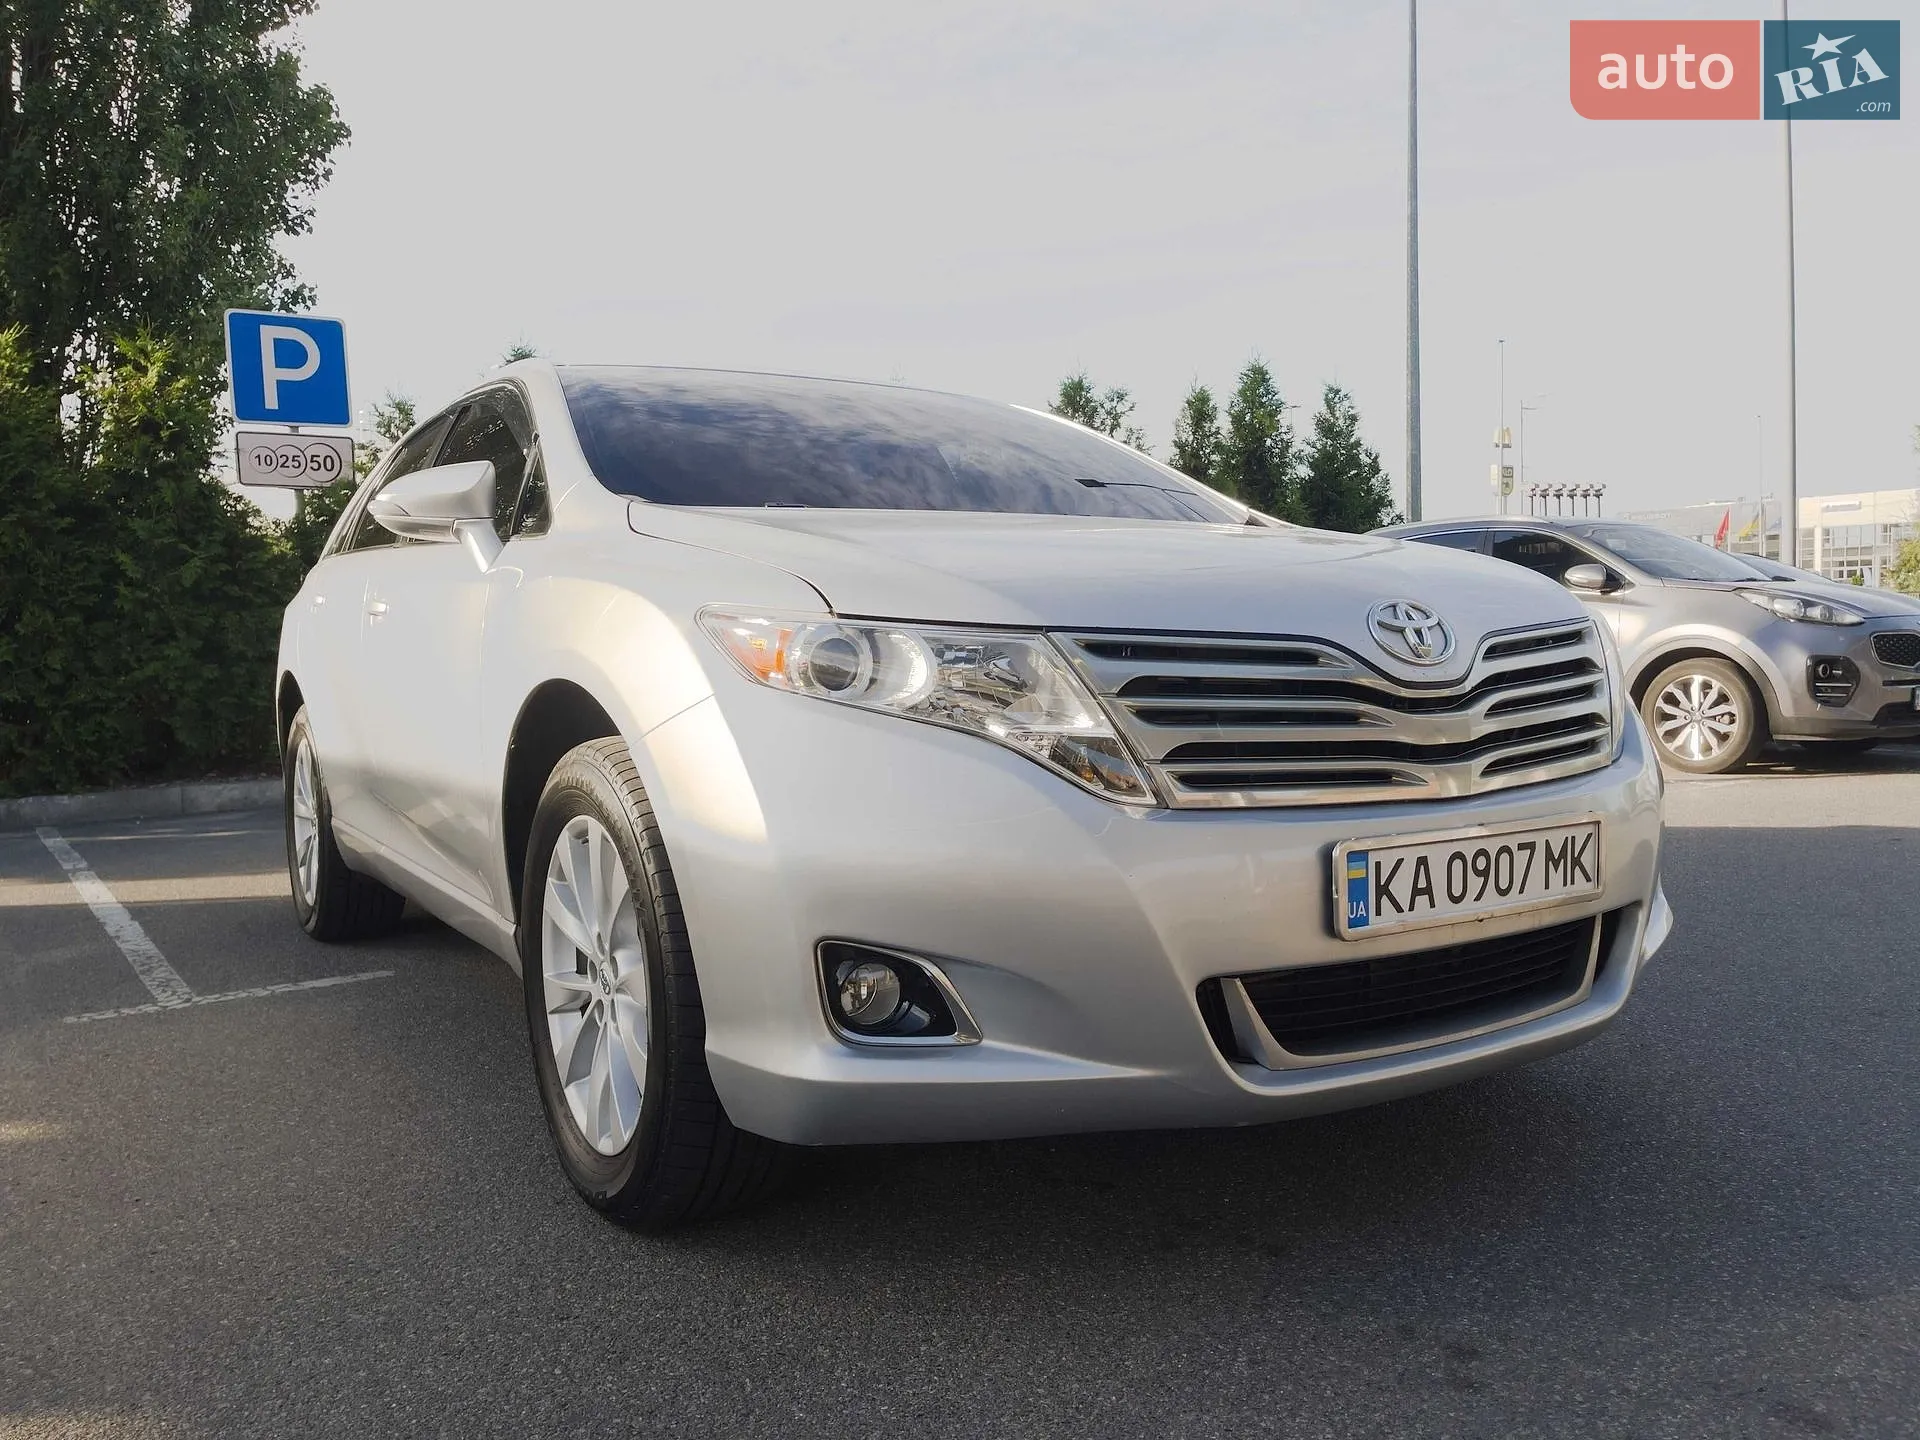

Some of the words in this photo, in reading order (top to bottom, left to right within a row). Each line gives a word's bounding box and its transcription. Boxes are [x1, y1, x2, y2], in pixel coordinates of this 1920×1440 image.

[259, 324, 321, 410] P
[254, 454, 273, 467] 10
[279, 454, 301, 469] 25
[309, 454, 335, 472] 50
[1374, 855, 1436, 917] KA
[1446, 840, 1537, 905] 0907
[1544, 832, 1593, 890] MK
[1348, 902, 1367, 919] UA
